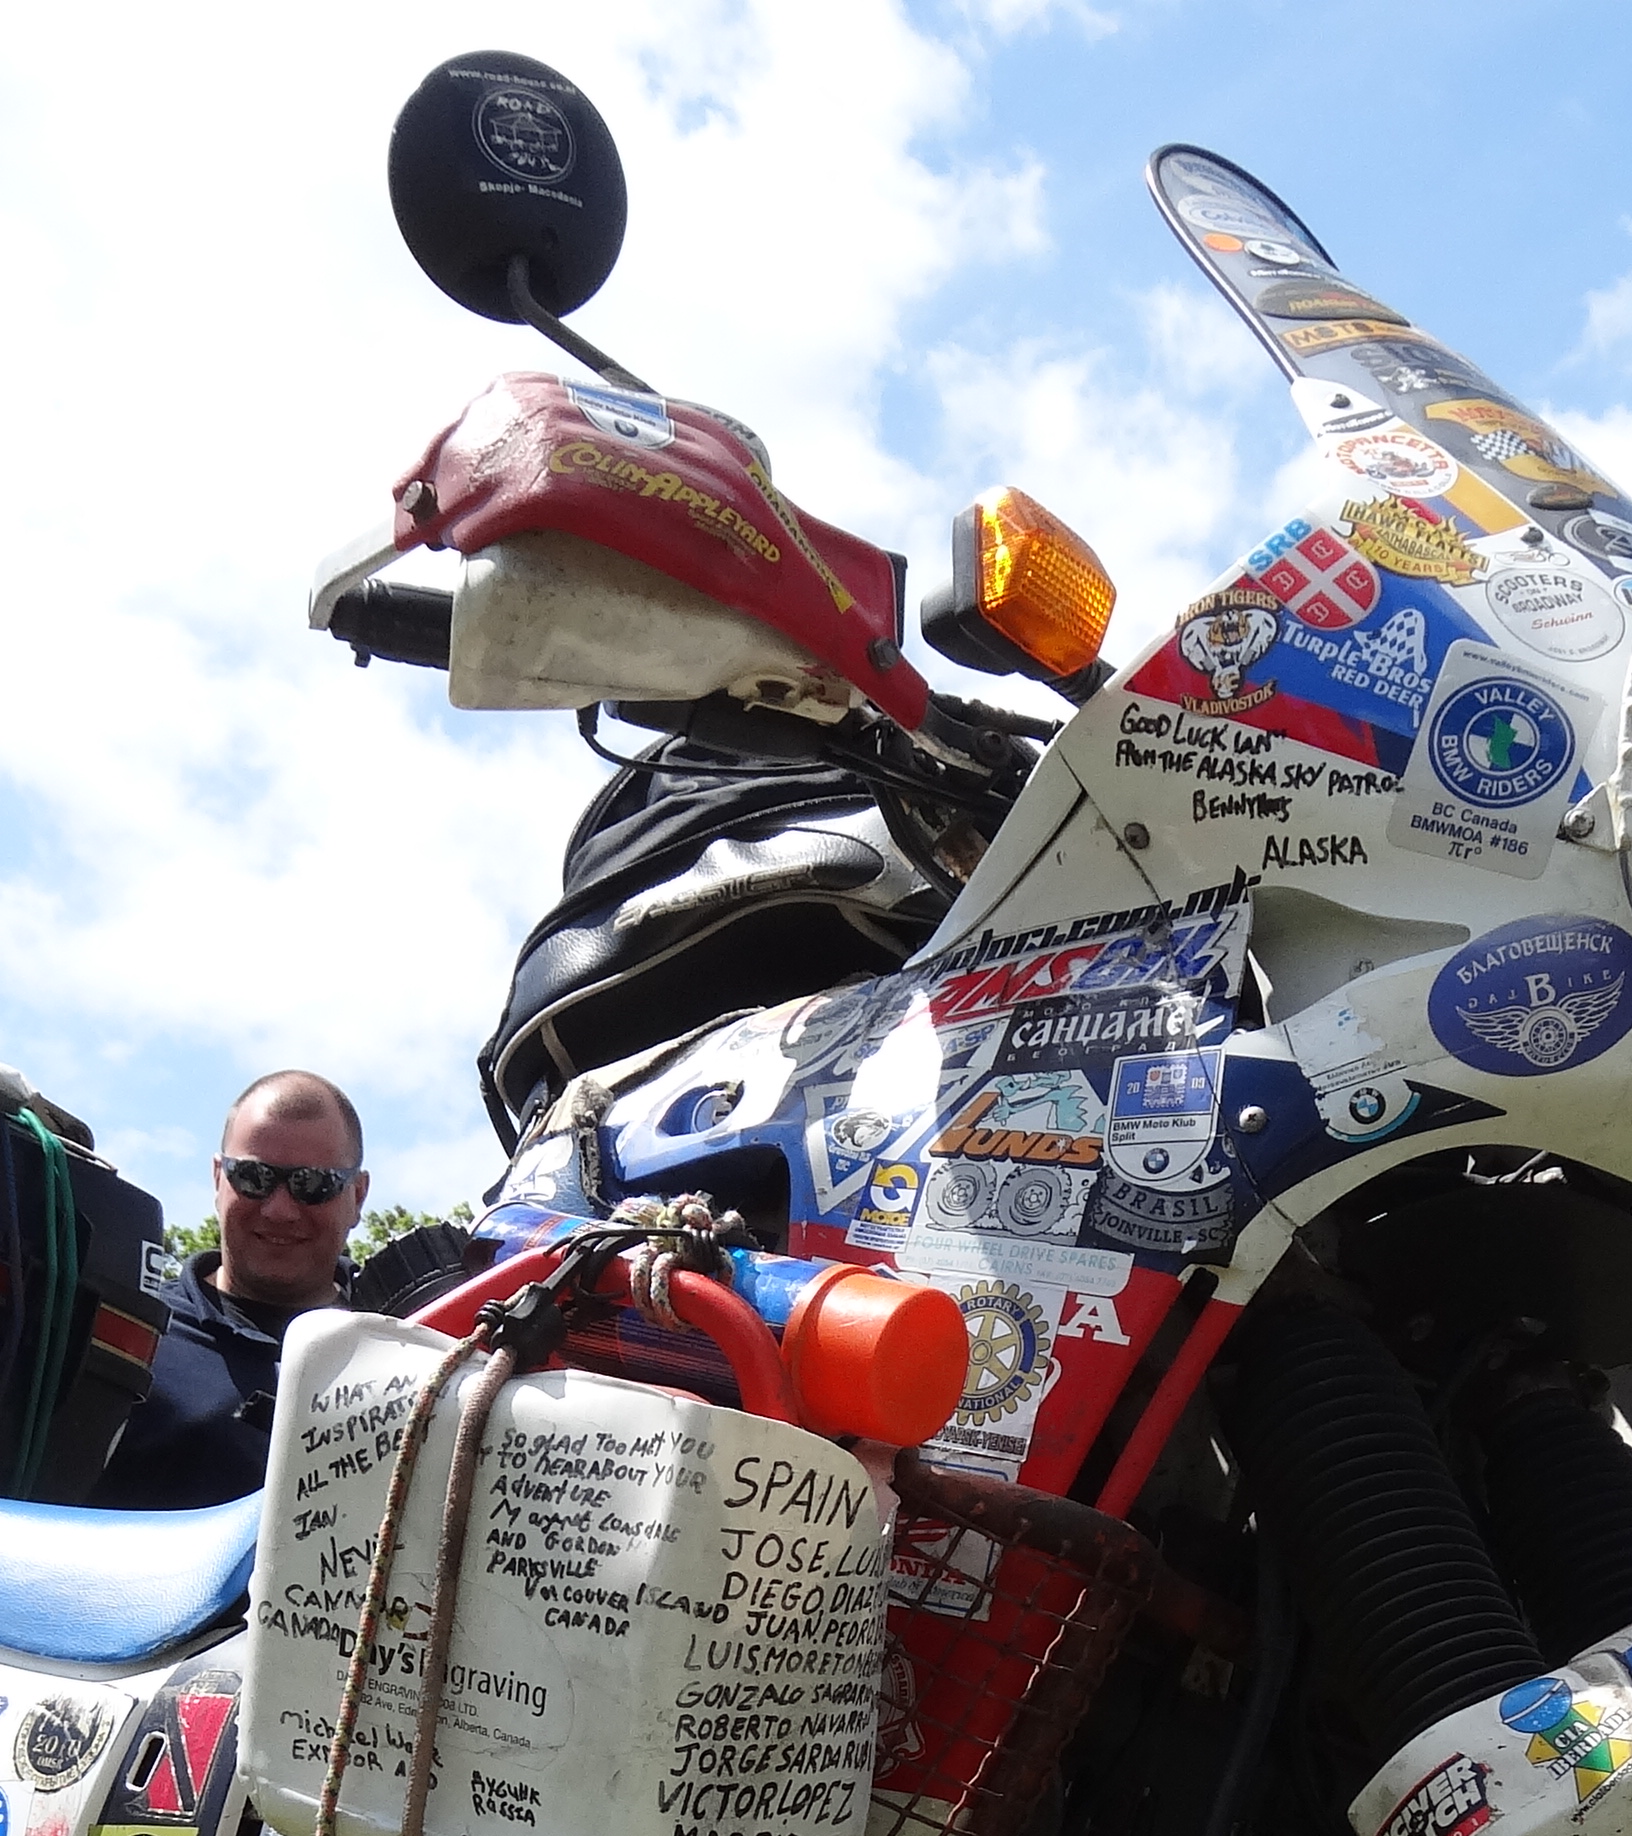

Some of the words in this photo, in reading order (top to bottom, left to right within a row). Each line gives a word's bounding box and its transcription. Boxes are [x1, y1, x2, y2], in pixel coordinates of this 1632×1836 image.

[1248, 517, 1313, 572] SRB
[1393, 554, 1445, 575] YEARS
[1218, 589, 1279, 611] TIGERS
[1495, 574, 1583, 605] SCOOTERS
[1511, 592, 1584, 614] BROADWAY
[1531, 610, 1594, 630] Schwinn
[1331, 665, 1369, 690] RED
[1372, 677, 1424, 712] DEER
[1368, 653, 1433, 694] BROS
[1181, 680, 1277, 715] VLADIVOSTOK
[1474, 687, 1556, 722] VALLEY
[1172, 712, 1228, 752] LUCK
[1196, 755, 1278, 787] ALASKA
[1441, 734, 1474, 783] BMW
[1476, 758, 1554, 797] RIDERS
[1410, 814, 1484, 844] BMWMOA
[1489, 836, 1530, 856] #186
[1432, 801, 1456, 818] BC
[1461, 808, 1519, 835] Canada
[1262, 833, 1368, 871] ALASKA
[1456, 930, 1615, 985] БЛАГОВЕЩЕНСК
[928, 1092, 1104, 1169] LUNDS
[1112, 1131, 1136, 1142] Split
[1113, 1120, 1142, 1131] BMW
[1143, 1118, 1170, 1130] Moto
[1172, 1116, 1196, 1128] Klub
[1112, 1184, 1218, 1218] BRASIL
[1098, 1212, 1183, 1244] JOINVILLE
[1198, 1228, 1218, 1243] SC
[914, 1235, 955, 1251] FOUR
[958, 1237, 1004, 1255] WHEEL
[1009, 1244, 1056, 1264] DRIVE
[1058, 1253, 1118, 1271] SPARES
[978, 1257, 1034, 1276] CAIRNS
[966, 1296, 1020, 1321] ROTARY
[958, 1377, 1022, 1411] NATIONAL
[297, 1468, 329, 1501] ALL
[330, 1448, 373, 1479] THE
[723, 1456, 869, 1530] SPAIN
[544, 1606, 631, 1637] CANADA
[493, 1728, 532, 1750] Canada
[674, 1713, 793, 1743] ROBERTO
[1553, 1720, 1589, 1750] CIA
[670, 1742, 778, 1778] JORGE
